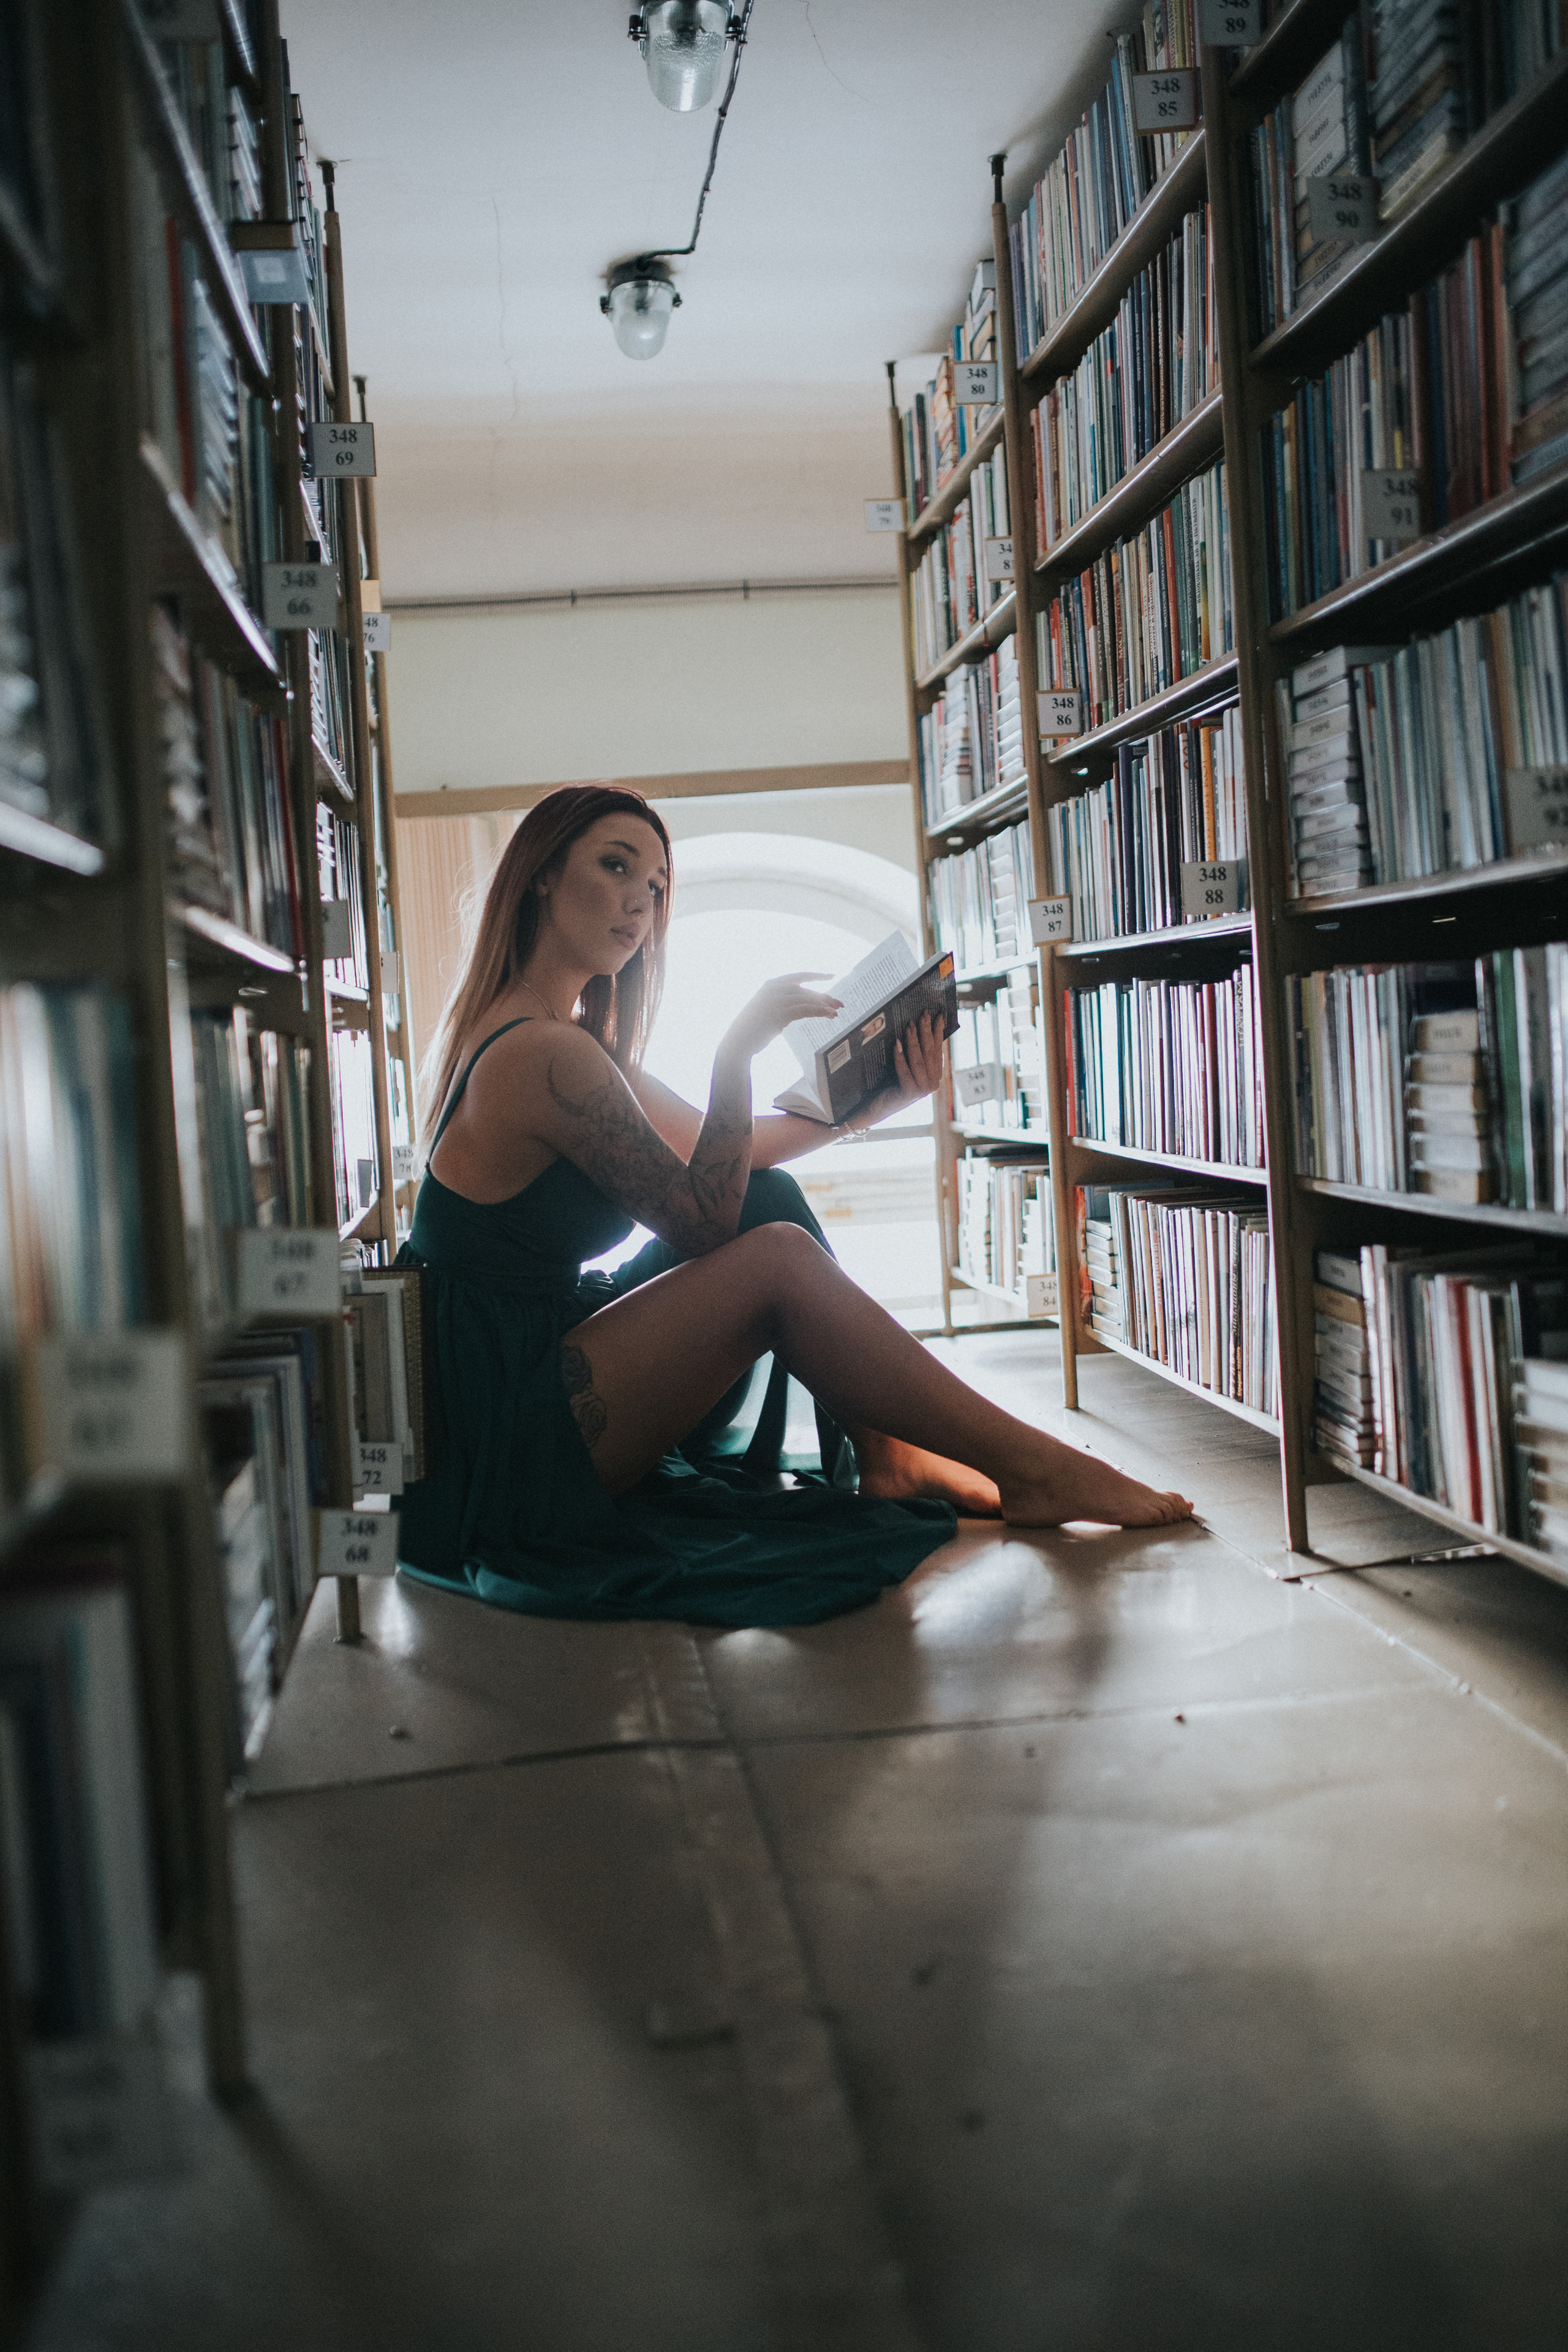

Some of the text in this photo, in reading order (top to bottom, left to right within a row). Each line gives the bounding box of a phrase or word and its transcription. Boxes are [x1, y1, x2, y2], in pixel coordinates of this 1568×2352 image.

[1226, 17, 1246, 33] 89
[1152, 78, 1180, 95] 348
[1158, 102, 1177, 116] 85
[1330, 183, 1362, 202] 348
[1336, 211, 1357, 227] 90
[967, 368, 988, 379] 348
[971, 384, 985, 395] 80
[330, 429, 358, 443] 348
[336, 451, 354, 466] 69
[1391, 507, 1413, 525] 91
[999, 543, 1012, 554] 34
[281, 570, 317, 588] 348
[364, 617, 378, 627] 48
[1052, 697, 1074, 709] 348
[1056, 714, 1072, 725] 86
[1199, 867, 1226, 882] 348
[1205, 889, 1223, 904] 88
[1042, 903, 1063, 916] 348
[1048, 920, 1061, 932] 87
[968, 1070, 986, 1082] 348
[1039, 1281, 1057, 1292] 348
[1042, 1296, 1056, 1306] 84
[363, 1471, 381, 1484] 72
[341, 1520, 377, 1536] 348
